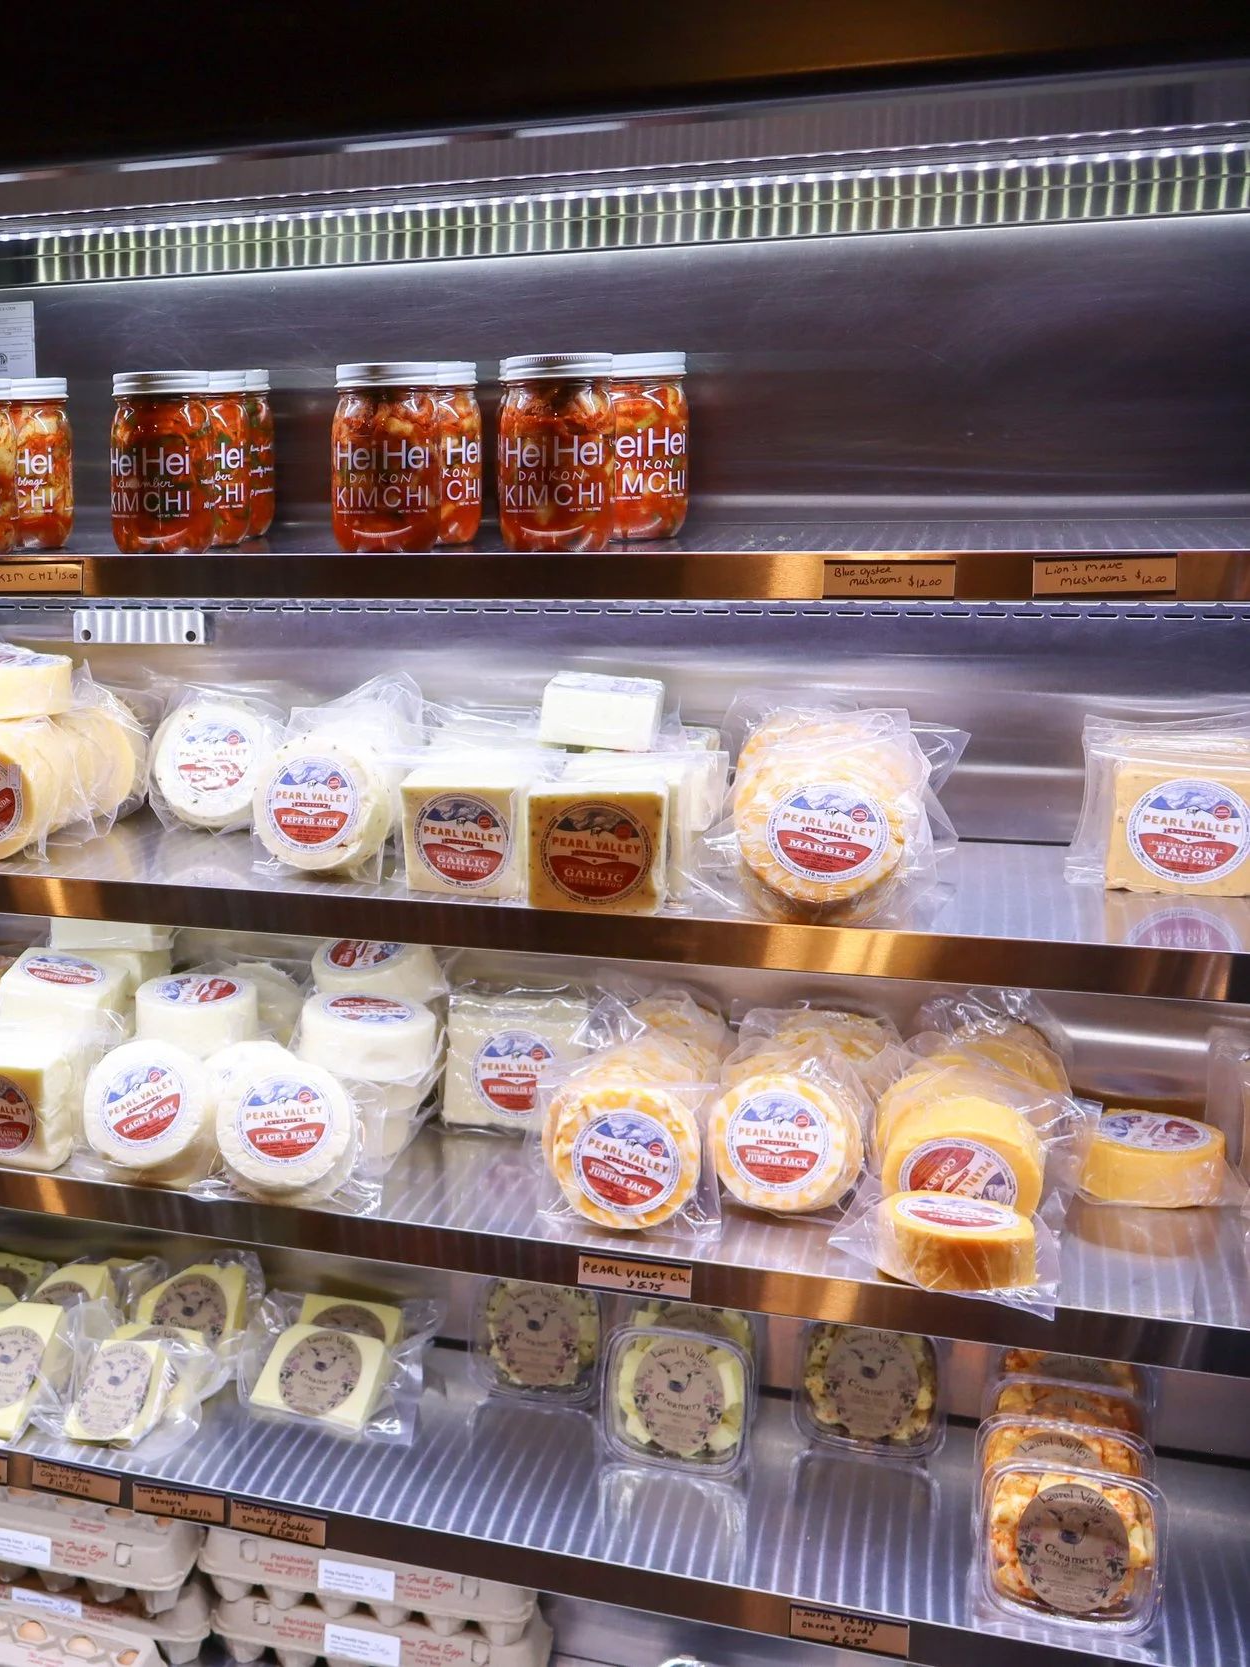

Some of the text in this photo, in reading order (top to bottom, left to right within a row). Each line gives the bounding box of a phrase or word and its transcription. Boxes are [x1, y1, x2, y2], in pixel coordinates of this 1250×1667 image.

[142, 445, 190, 476] Hei
[336, 438, 429, 470] Hei Hei
[505, 434, 603, 468] Hei Hei
[117, 478, 174, 489] cucumber
[349, 472, 413, 483] DAIKON
[518, 470, 586, 482] DAIKON
[111, 490, 190, 512] KIMCHI
[336, 485, 429, 508] KIMCHI
[505, 482, 603, 507] KIMCHI
[834, 567, 855, 578] Blue
[275, 790, 349, 803] PEARL VALLEY
[281, 815, 340, 827] PEPPER JACK
[782, 812, 877, 838] PEARL VALLEY
[1142, 814, 1241, 835] PEARL VALLEY
[423, 825, 502, 844] PEARL VALLEY
[552, 835, 641, 855] PEARL VALLEY
[788, 838, 856, 859] MARBLE
[1156, 845, 1217, 861] BACON
[436, 854, 490, 869] GARLIC
[1191, 858, 1218, 867] FOOD
[563, 868, 625, 883] GARLIC
[481, 1063, 513, 1071] PEARL
[108, 1079, 174, 1117] PEARL VALLEY
[245, 1106, 323, 1120] PEARL VALLEY
[255, 1129, 317, 1143] LACEY BABY
[738, 1127, 819, 1142] PEARL VALLEY
[588, 1138, 670, 1174] PEARL VALLEY
[746, 1154, 809, 1167] JUMPIN JACK
[588, 1166, 653, 1195] JUMPIN JACK
[924, 1158, 957, 1191] COLBY
[964, 1161, 994, 1187] PEARL
[651, 1346, 710, 1369] Laurel Valley
[656, 1392, 702, 1412] Creamery
[1019, 1437, 1093, 1460] Laurel Valley
[1037, 1489, 1113, 1518] Laurel Valley
[270, 1552, 314, 1566] Perishable
[1045, 1542, 1099, 1566] Creamery
